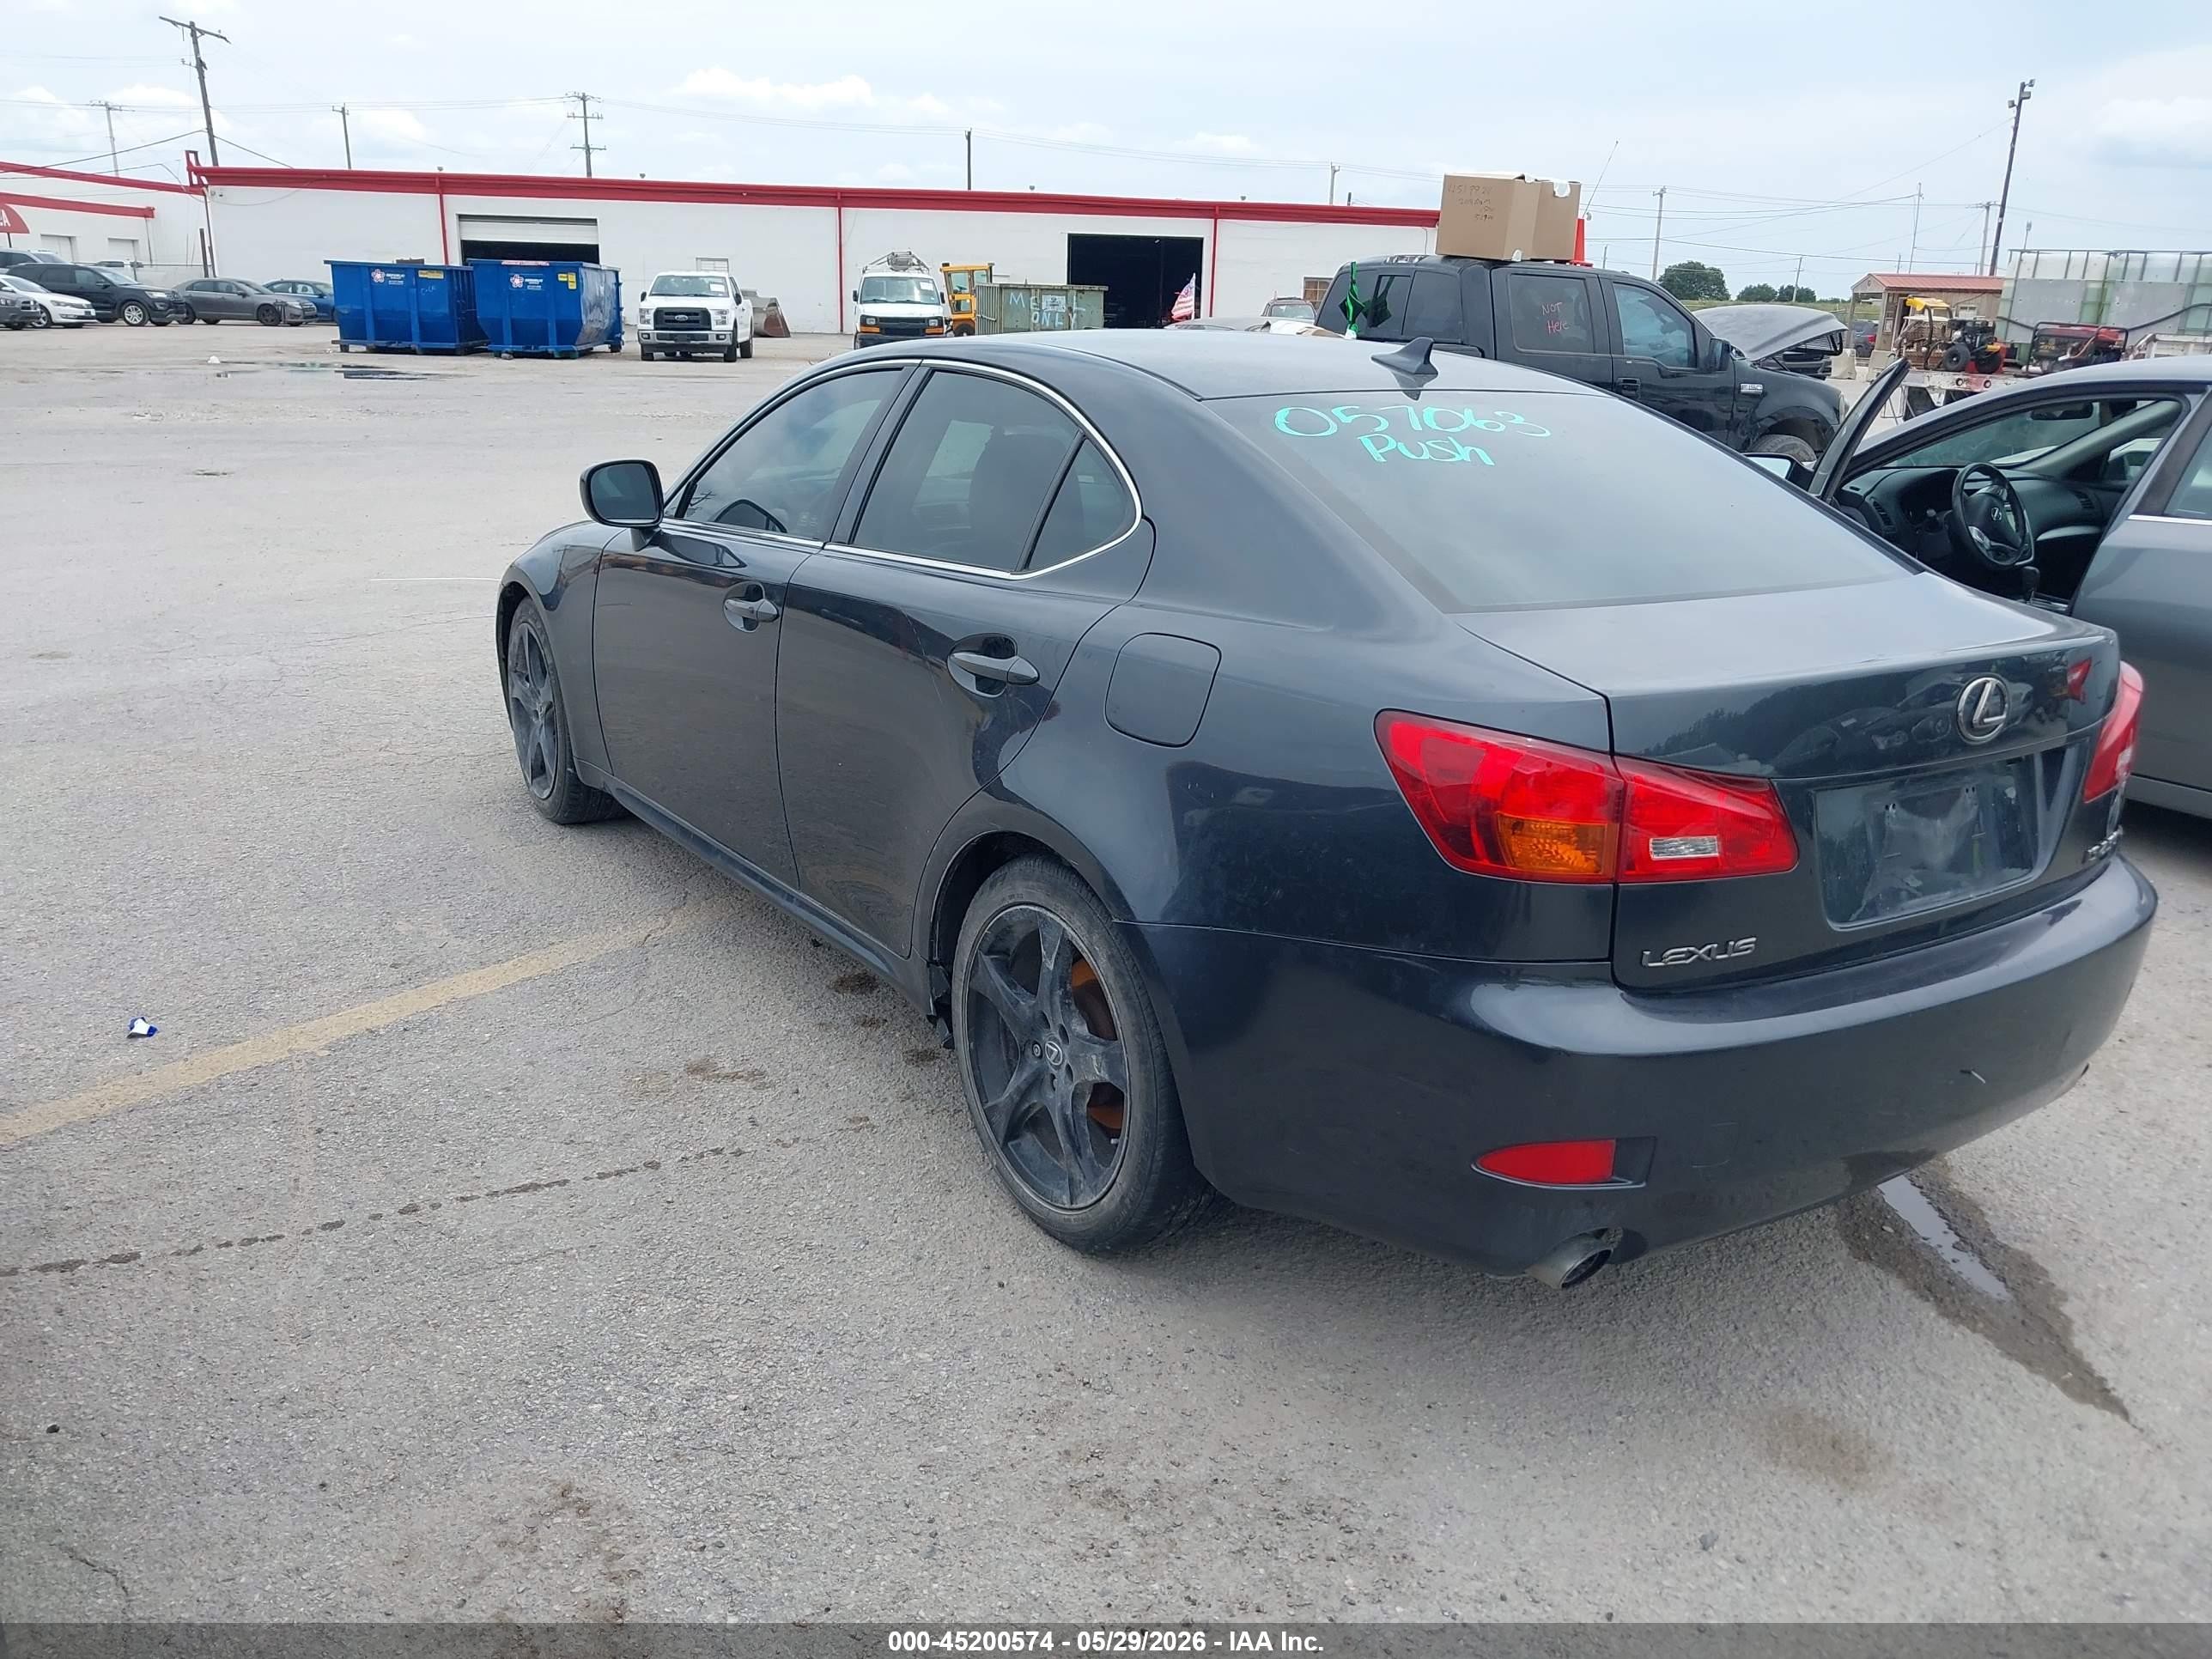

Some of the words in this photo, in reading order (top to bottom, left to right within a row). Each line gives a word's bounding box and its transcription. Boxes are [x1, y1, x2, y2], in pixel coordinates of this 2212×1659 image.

[1031, 311, 1077, 330] ONLY
[1541, 302, 1563, 316] NOT
[1274, 405, 1551, 437] 057063
[1357, 433, 1495, 466] Push
[1642, 937, 1757, 967] LEXUS
